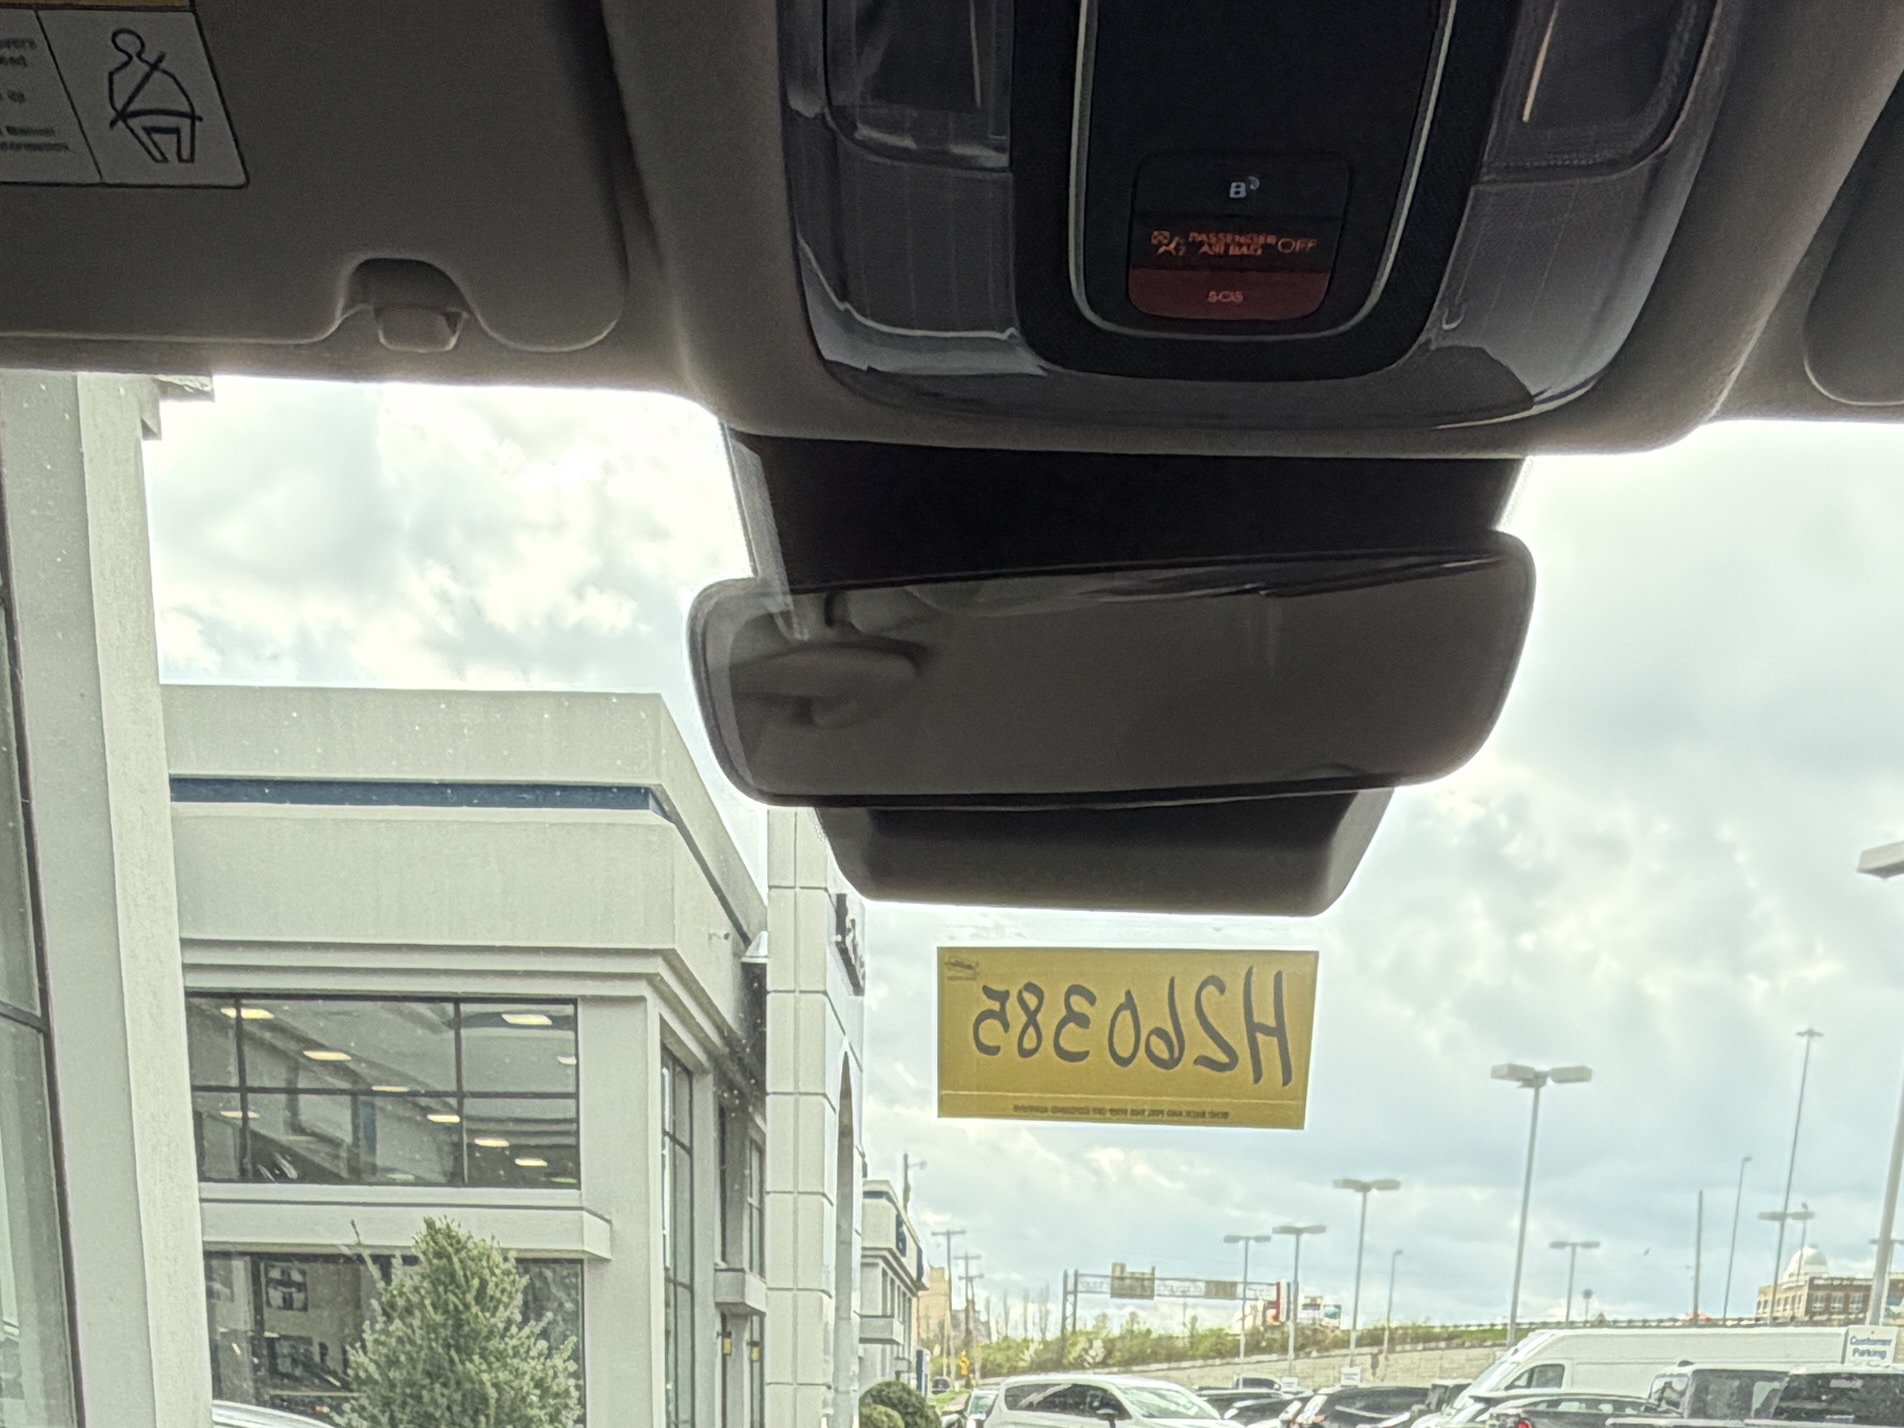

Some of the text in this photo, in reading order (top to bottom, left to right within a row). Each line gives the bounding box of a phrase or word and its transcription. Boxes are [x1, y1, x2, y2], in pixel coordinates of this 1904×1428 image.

[1187, 231, 1278, 246] PASSENGER
[1277, 237, 1319, 254] OFF
[1198, 243, 1264, 257] AIR BAG
[1206, 289, 1245, 304] SOS
